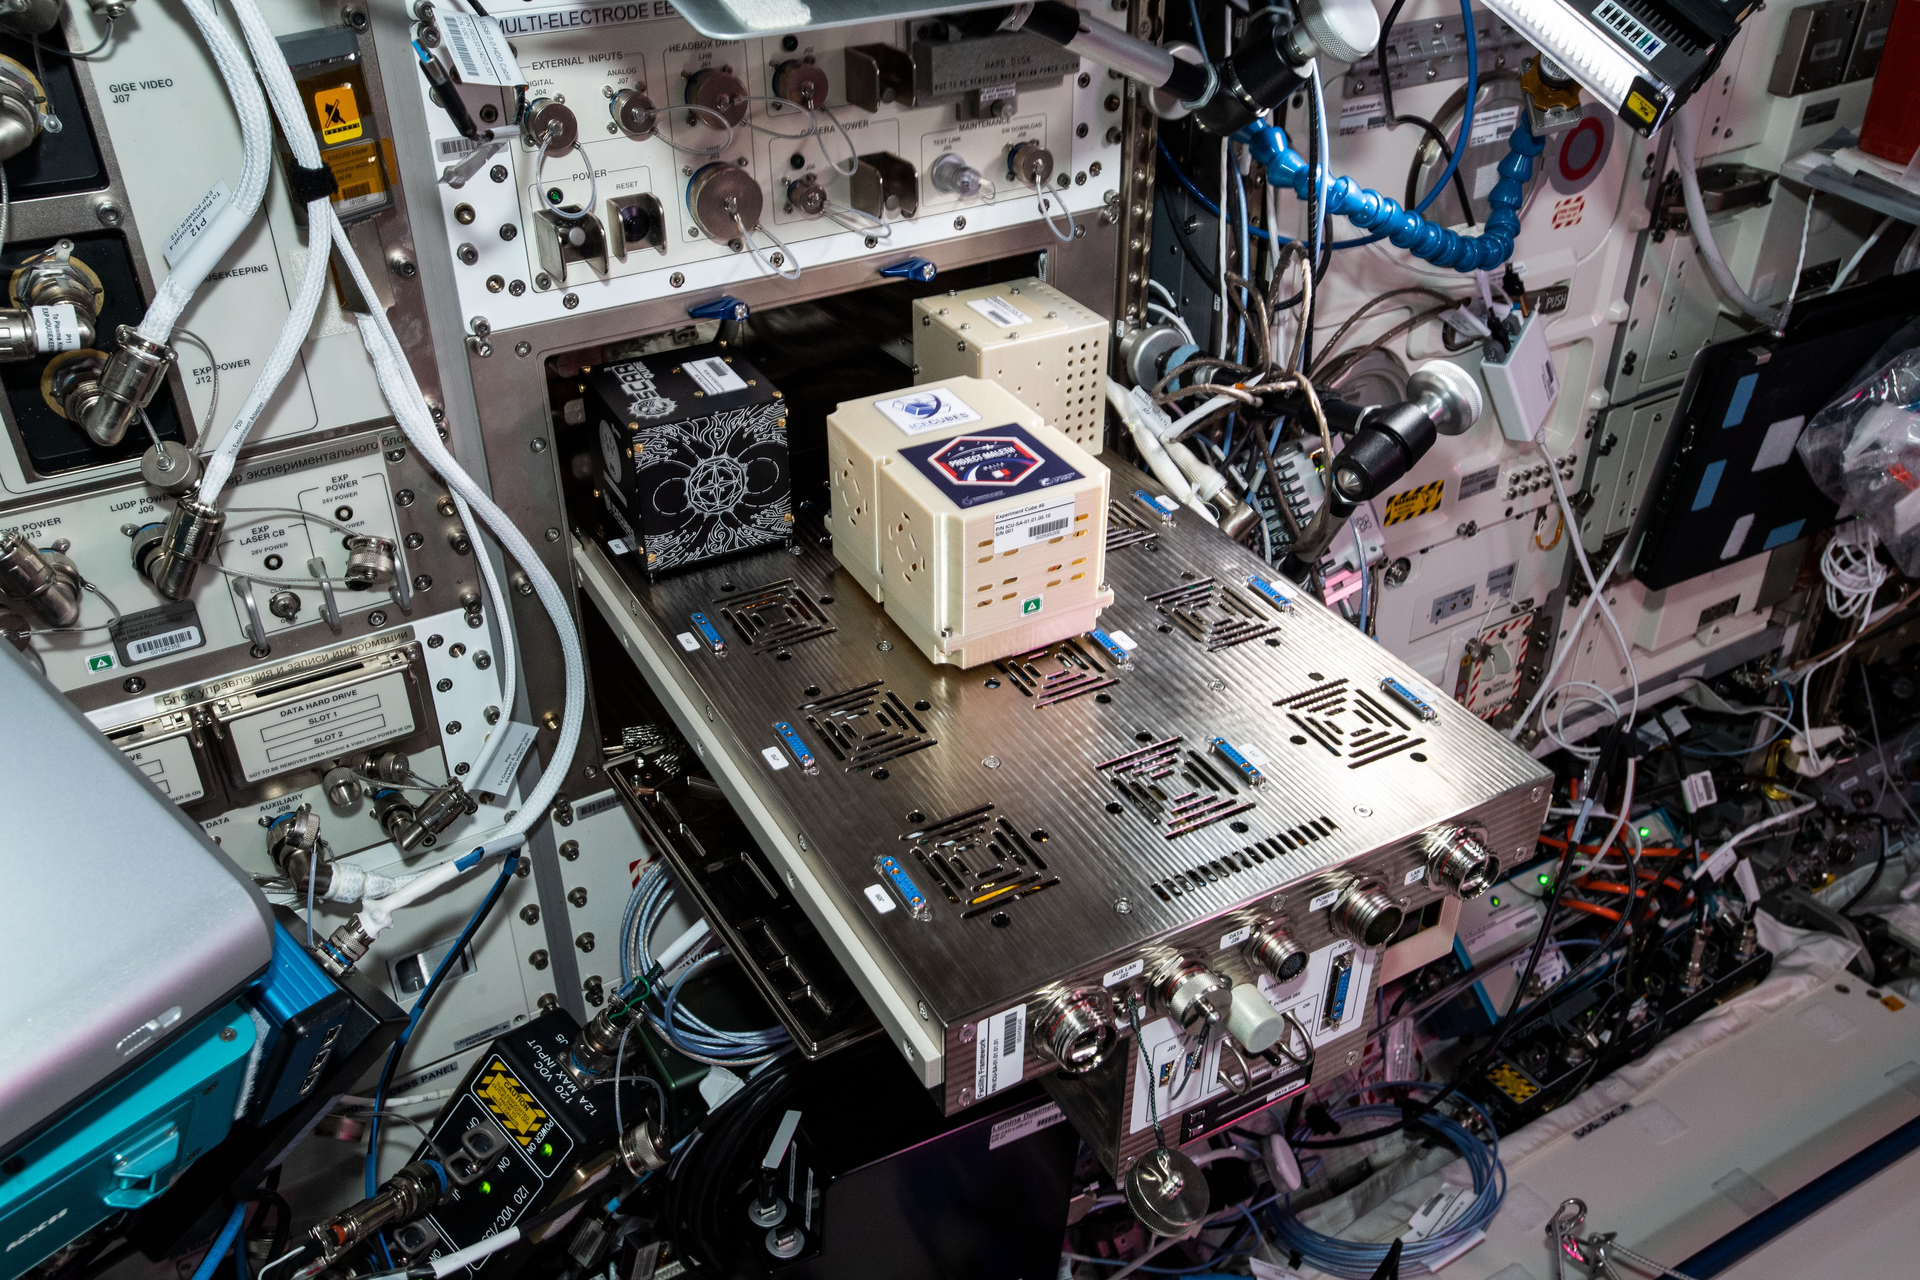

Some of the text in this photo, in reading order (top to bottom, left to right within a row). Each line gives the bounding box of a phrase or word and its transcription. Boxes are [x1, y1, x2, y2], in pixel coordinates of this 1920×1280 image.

[654, 0, 676, 16] EE
[480, 20, 512, 82] USB 3.0 HDD Cable
[668, 40, 713, 53] HEADBOX
[532, 51, 623, 71] EXTERNAL INPUTS
[1011, 55, 1032, 67] DISK
[606, 67, 637, 77] ANALOG
[109, 78, 174, 93] GIGE VIDEO
[534, 88, 547, 96] J04
[113, 94, 130, 104] J07
[958, 117, 1012, 132] MAINTENANCE
[572, 169, 608, 182] POWER
[615, 181, 639, 190] RESET
[169, 191, 221, 251] To Plasma Kristall-4
[170, 190, 214, 241] EXP POWER J12
[190, 217, 208, 237] P12
[205, 264, 269, 282] USEKEEPING
[1546, 294, 1567, 309] PUSH
[42, 307, 50, 318] EXP
[54, 320, 63, 341] Plasma
[192, 358, 251, 377] EXP POWER
[195, 375, 211, 385] J12
[233, 419, 244, 430] P09
[909, 411, 970, 431] ICECUBES
[232, 421, 252, 449] Experiment
[246, 440, 379, 480] экспериментального
[948, 451, 983, 468] PROJECT
[331, 473, 349, 484] EXP
[325, 480, 359, 493] POWER
[110, 494, 170, 512] LUDP POWE
[334, 491, 359, 501] POWER
[138, 505, 155, 515] J09
[995, 504, 1038, 520] Experiment Cube
[22, 517, 62, 531] POWER
[251, 525, 270, 535] EXP
[26, 530, 42, 540] J13
[240, 529, 286, 546] LASER CB
[264, 542, 289, 552] POWER
[270, 584, 292, 594] CLOSE
[162, 630, 409, 706] Блок управления и записи информации
[280, 689, 358, 718] DATA HARD DRIVE
[308, 713, 331, 725] SLOT
[313, 733, 337, 745] SLOT
[129, 752, 143, 761] VE
[248, 771, 261, 779] NOT
[279, 756, 308, 769] REMOVED
[308, 751, 326, 760] WHEN
[325, 745, 346, 755] Control
[350, 739, 366, 747] Video
[377, 729, 398, 738] POWER
[260, 793, 303, 812] AUXILIARY
[276, 804, 291, 814] J08
[205, 817, 230, 829] DATA
[1409, 868, 1421, 877] LAN
[1315, 891, 1335, 904] POWER
[1228, 930, 1244, 940] DATA
[1112, 963, 1137, 978] AUX LAN
[1273, 996, 1293, 1007] POWER
[555, 1033, 569, 1045] J5
[1167, 1044, 1177, 1052] J23
[421, 1064, 458, 1083] PANEL
[977, 1038, 987, 1099] Facility Framework
[527, 1039, 597, 1116] 12A MAX INPUT
[534, 1061, 573, 1104] 120 VDC
[502, 1081, 529, 1111] CAUTION
[1274, 1088, 1287, 1096] DATA
[491, 1083, 529, 1125] OUTLET SWITCH OFF
[495, 1081, 530, 1120] TURN ASSOCIATED
[498, 1097, 511, 1111] PRIOR
[491, 1095, 519, 1127] MATE DEMATE
[526, 1119, 555, 1154] POWER ON
[497, 1156, 511, 1173] ON
[496, 1185, 530, 1227] 120 VDC
[428, 1248, 442, 1262] ON
